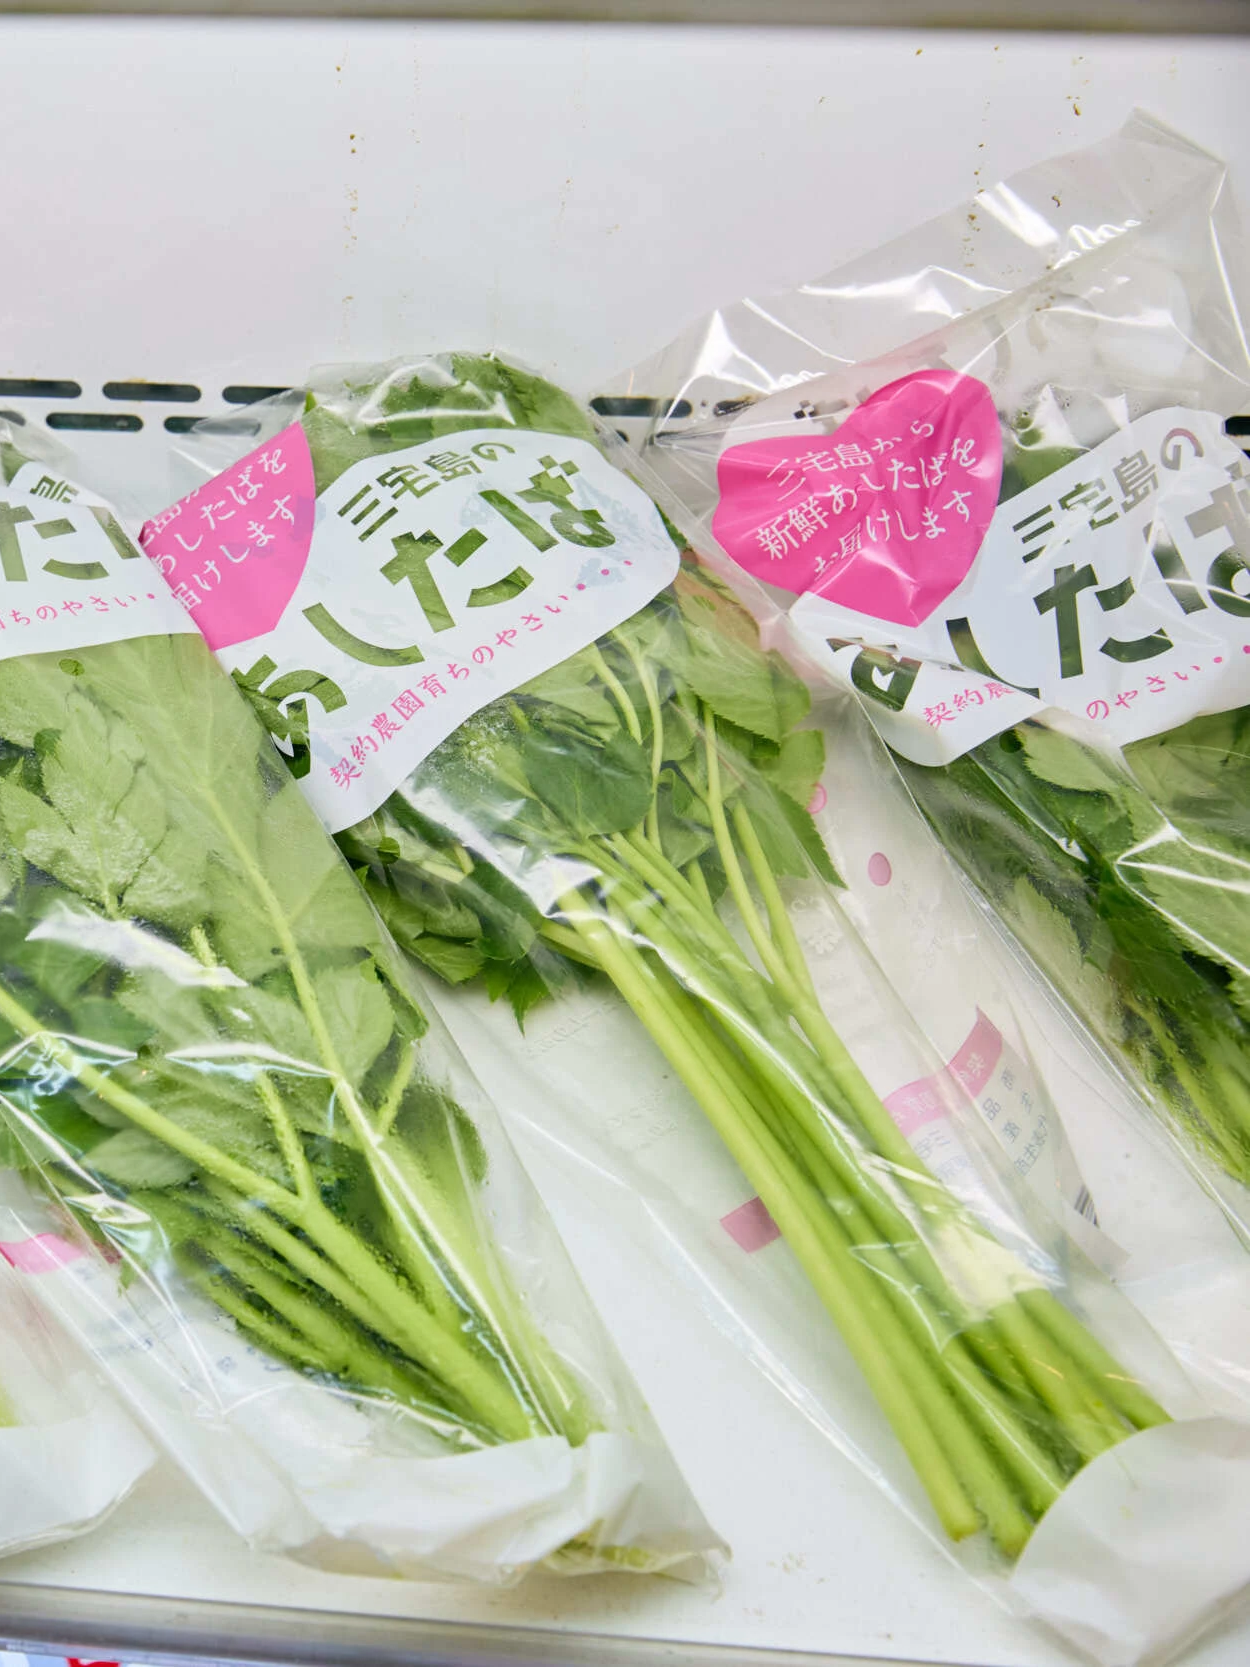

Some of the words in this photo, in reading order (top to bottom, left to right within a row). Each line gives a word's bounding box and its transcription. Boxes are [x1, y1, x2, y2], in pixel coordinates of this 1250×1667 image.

[337, 442, 515, 542] 三宅島の
[756, 438, 977, 561] 新鮮あしたばを
[767, 420, 935, 502] 三宅島から
[1013, 428, 1204, 564] 三宅島の
